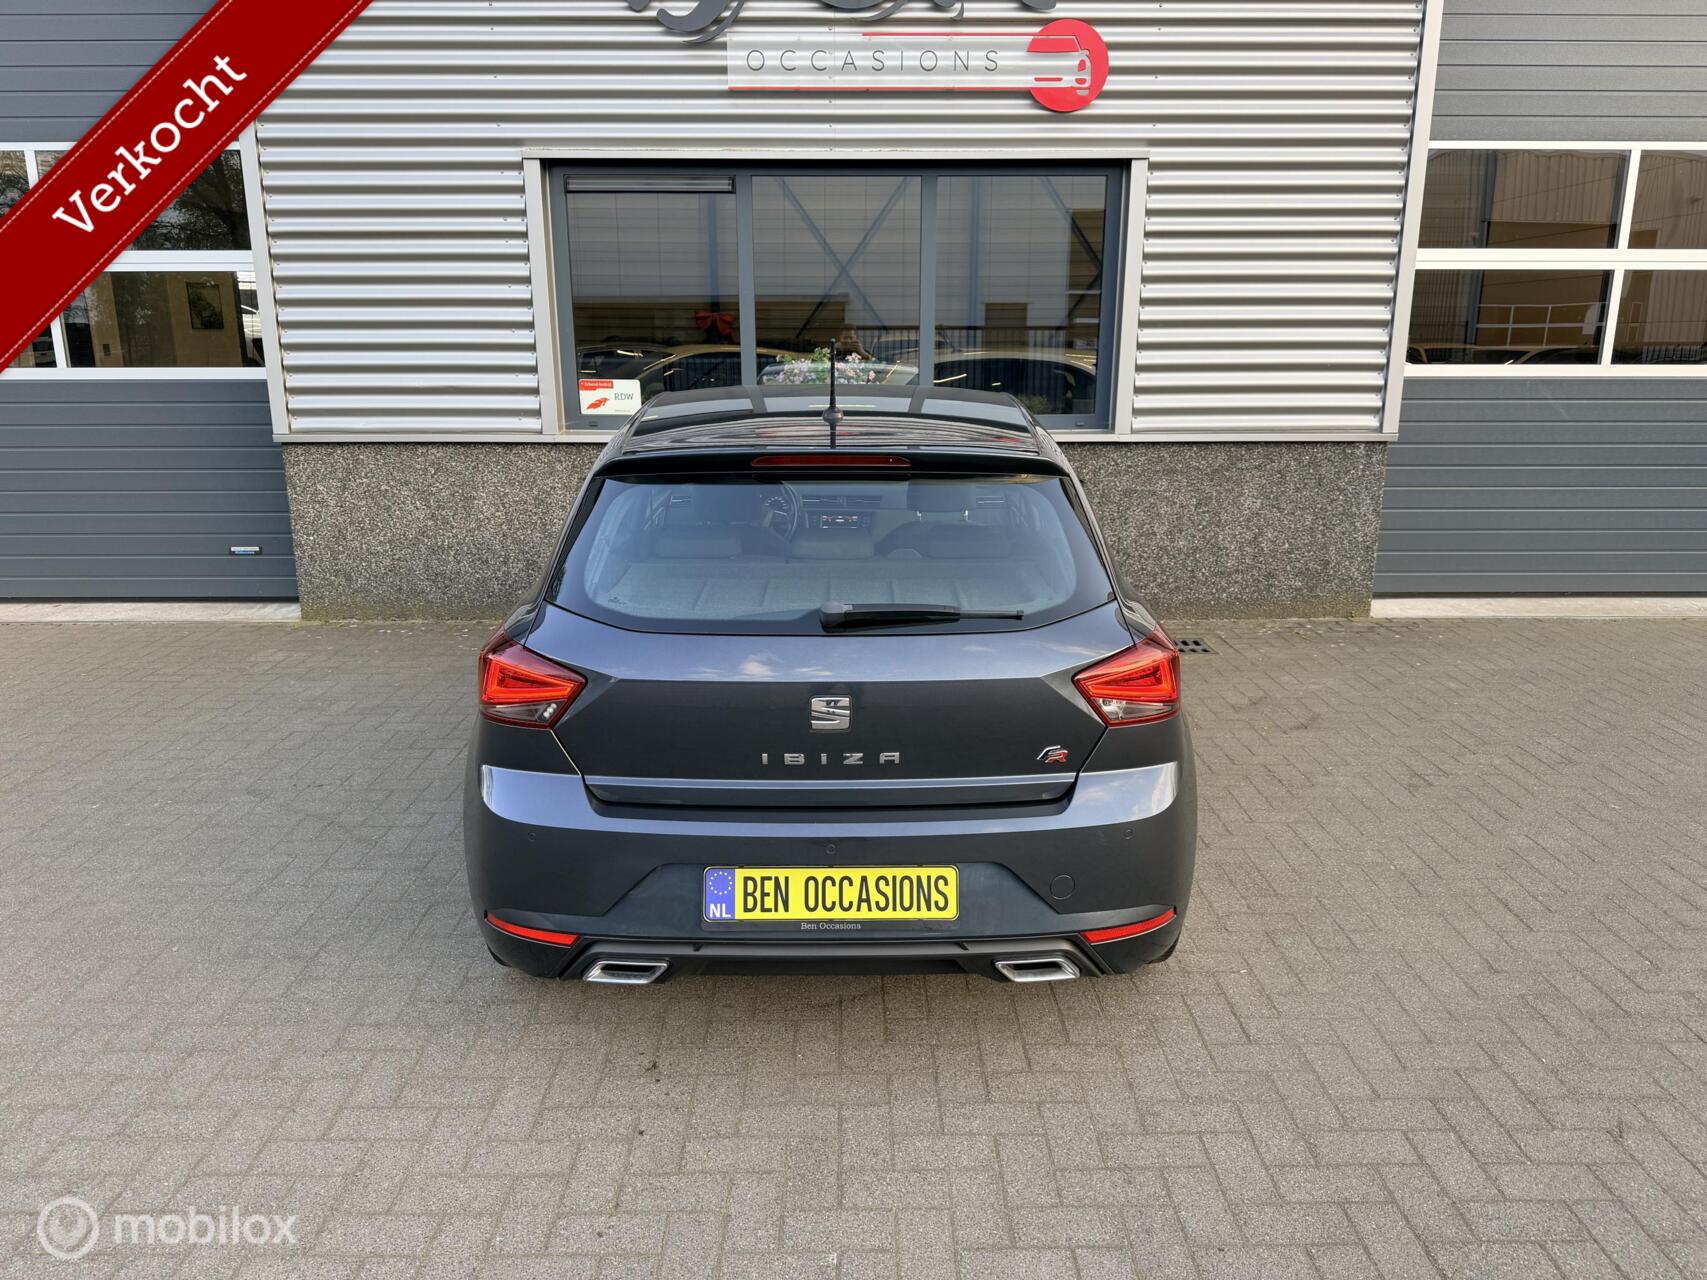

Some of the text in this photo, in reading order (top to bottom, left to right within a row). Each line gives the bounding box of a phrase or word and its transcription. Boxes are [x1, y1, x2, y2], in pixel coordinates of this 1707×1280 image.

[746, 50, 999, 72] OCCASIONS
[614, 393, 634, 401] RDW
[761, 752, 900, 765] IBIZA
[743, 875, 949, 913] BEN OCCASIONS
[709, 903, 731, 918] NL
[800, 922, 861, 930] Ben Occasions
